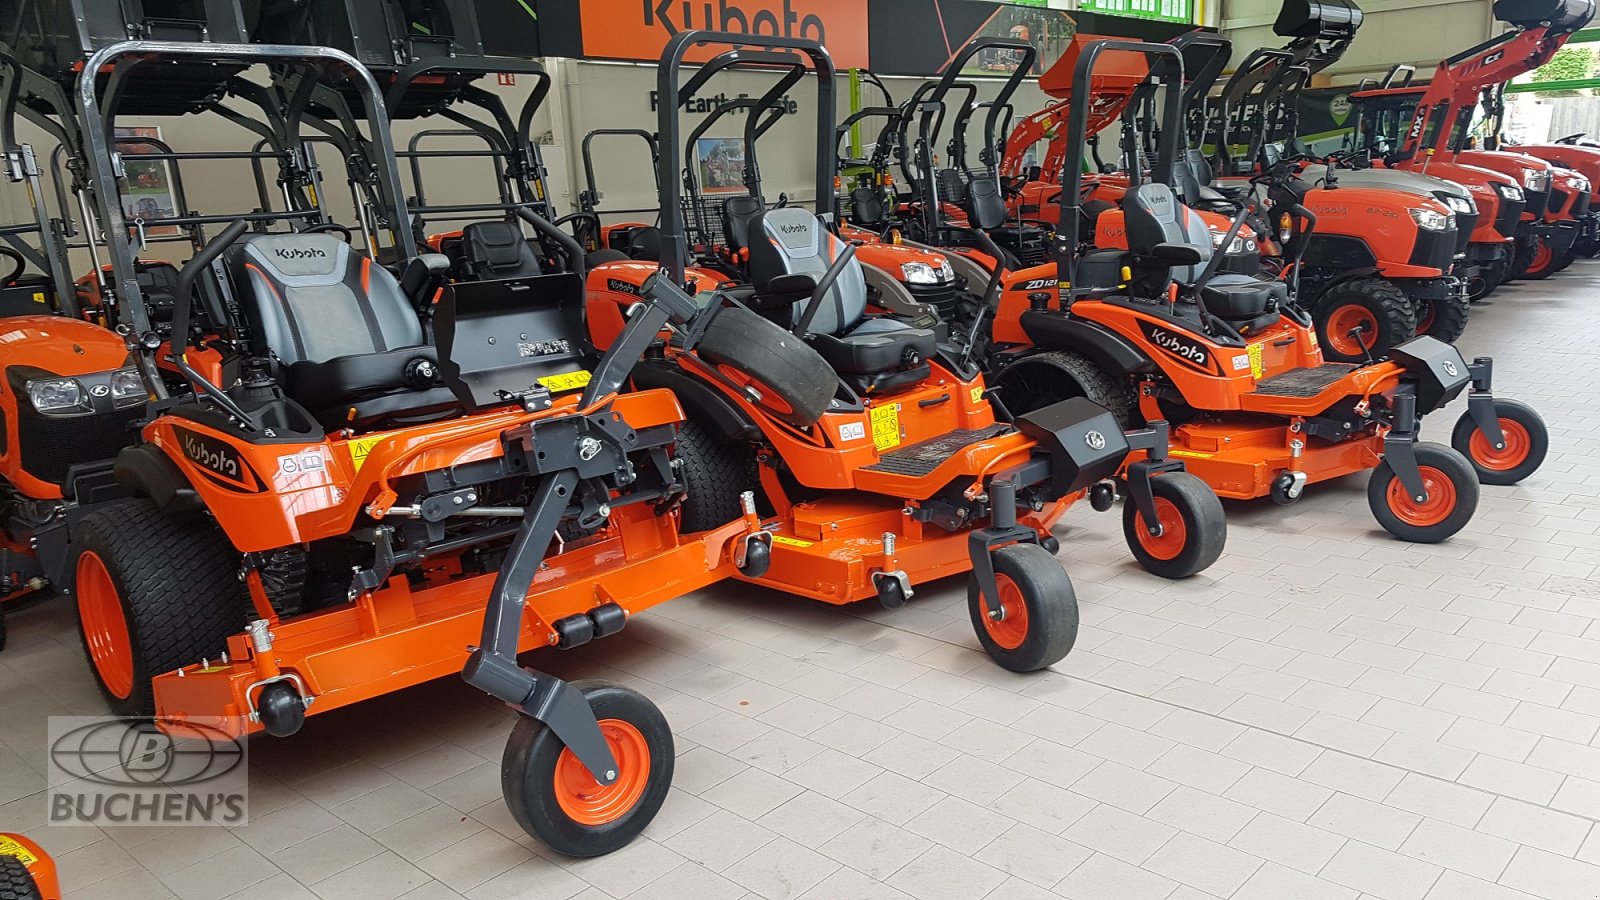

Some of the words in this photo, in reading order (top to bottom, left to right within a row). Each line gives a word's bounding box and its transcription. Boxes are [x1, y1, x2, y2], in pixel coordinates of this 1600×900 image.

[642, 0, 826, 53] Kubota
[780, 224, 808, 235] Kubota
[275, 248, 327, 259] Kubota
[610, 279, 635, 294] Kubota
[1151, 328, 1206, 364] Kubota
[184, 434, 238, 477] Kubota
